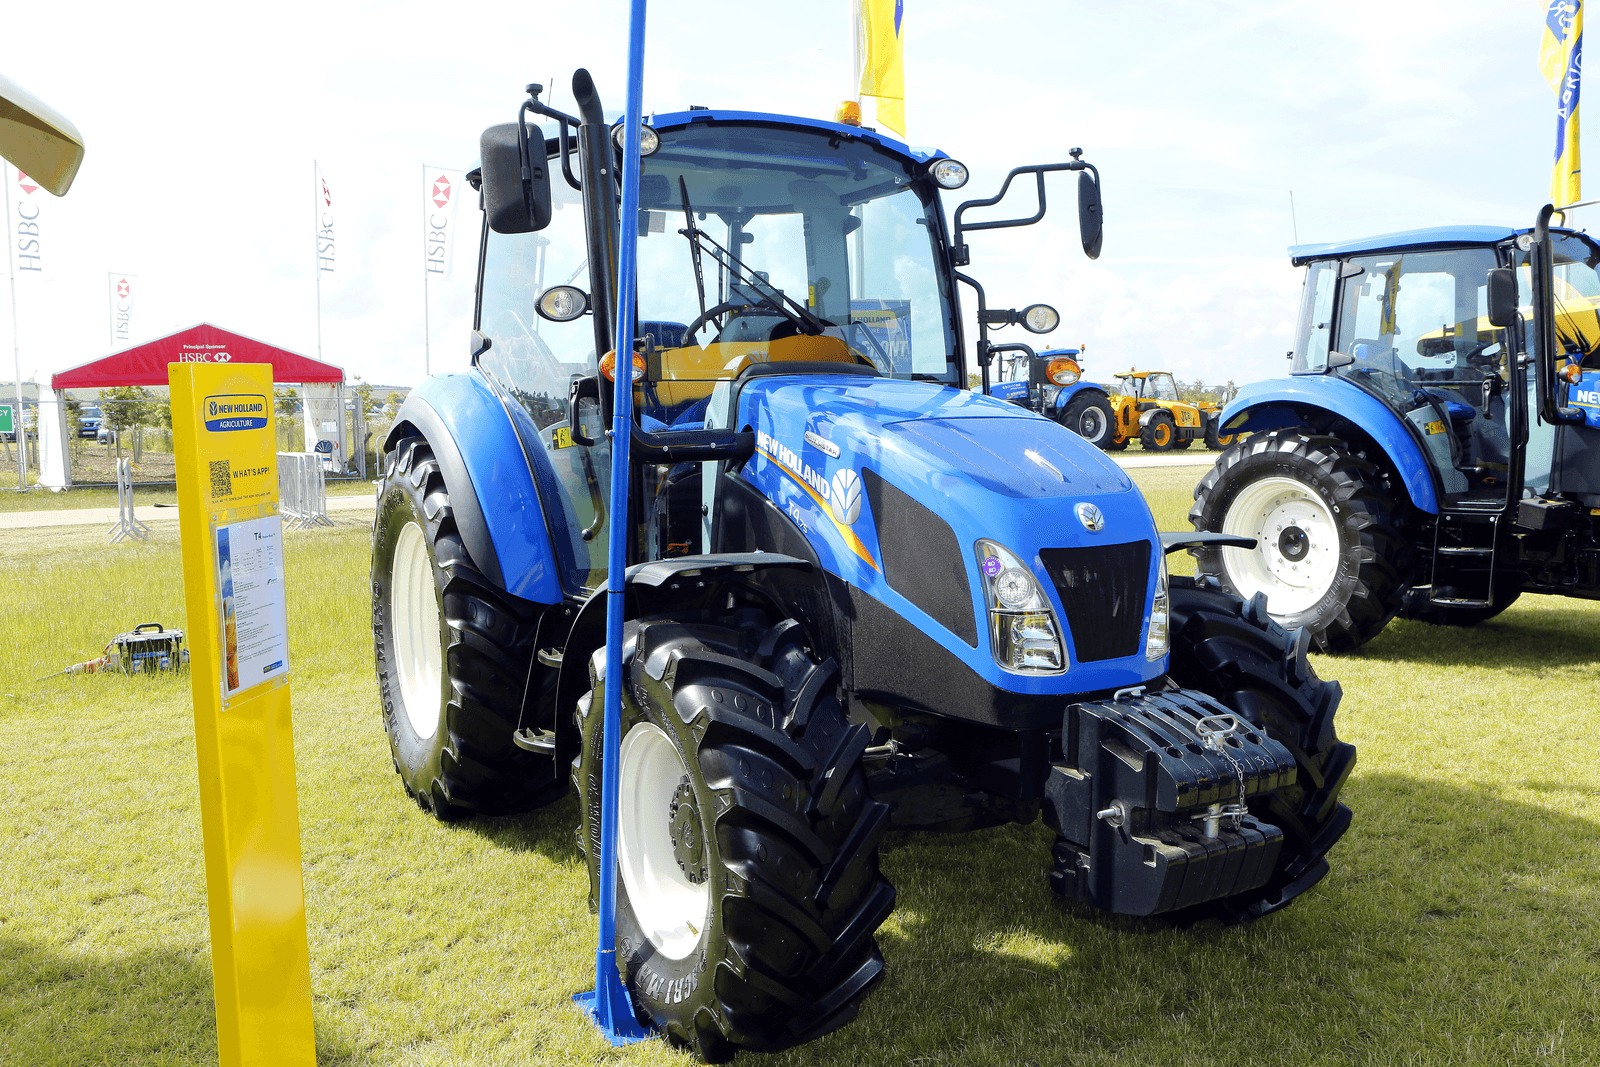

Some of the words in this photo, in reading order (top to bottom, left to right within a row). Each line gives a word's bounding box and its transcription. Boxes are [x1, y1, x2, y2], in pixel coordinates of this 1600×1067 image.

[18, 201, 42, 272] HSBC
[318, 212, 335, 272] HSBC
[427, 213, 448, 275] HSBC
[116, 301, 130, 341] HSBC
[178, 352, 212, 363] HSBC
[218, 405, 233, 414] NEW
[234, 403, 263, 413] HOLLAND
[1576, 390, 1600, 405] NE
[219, 419, 253, 429] AGRICULTURE
[757, 429, 779, 457] NEW
[779, 443, 831, 501] HOLLAND
